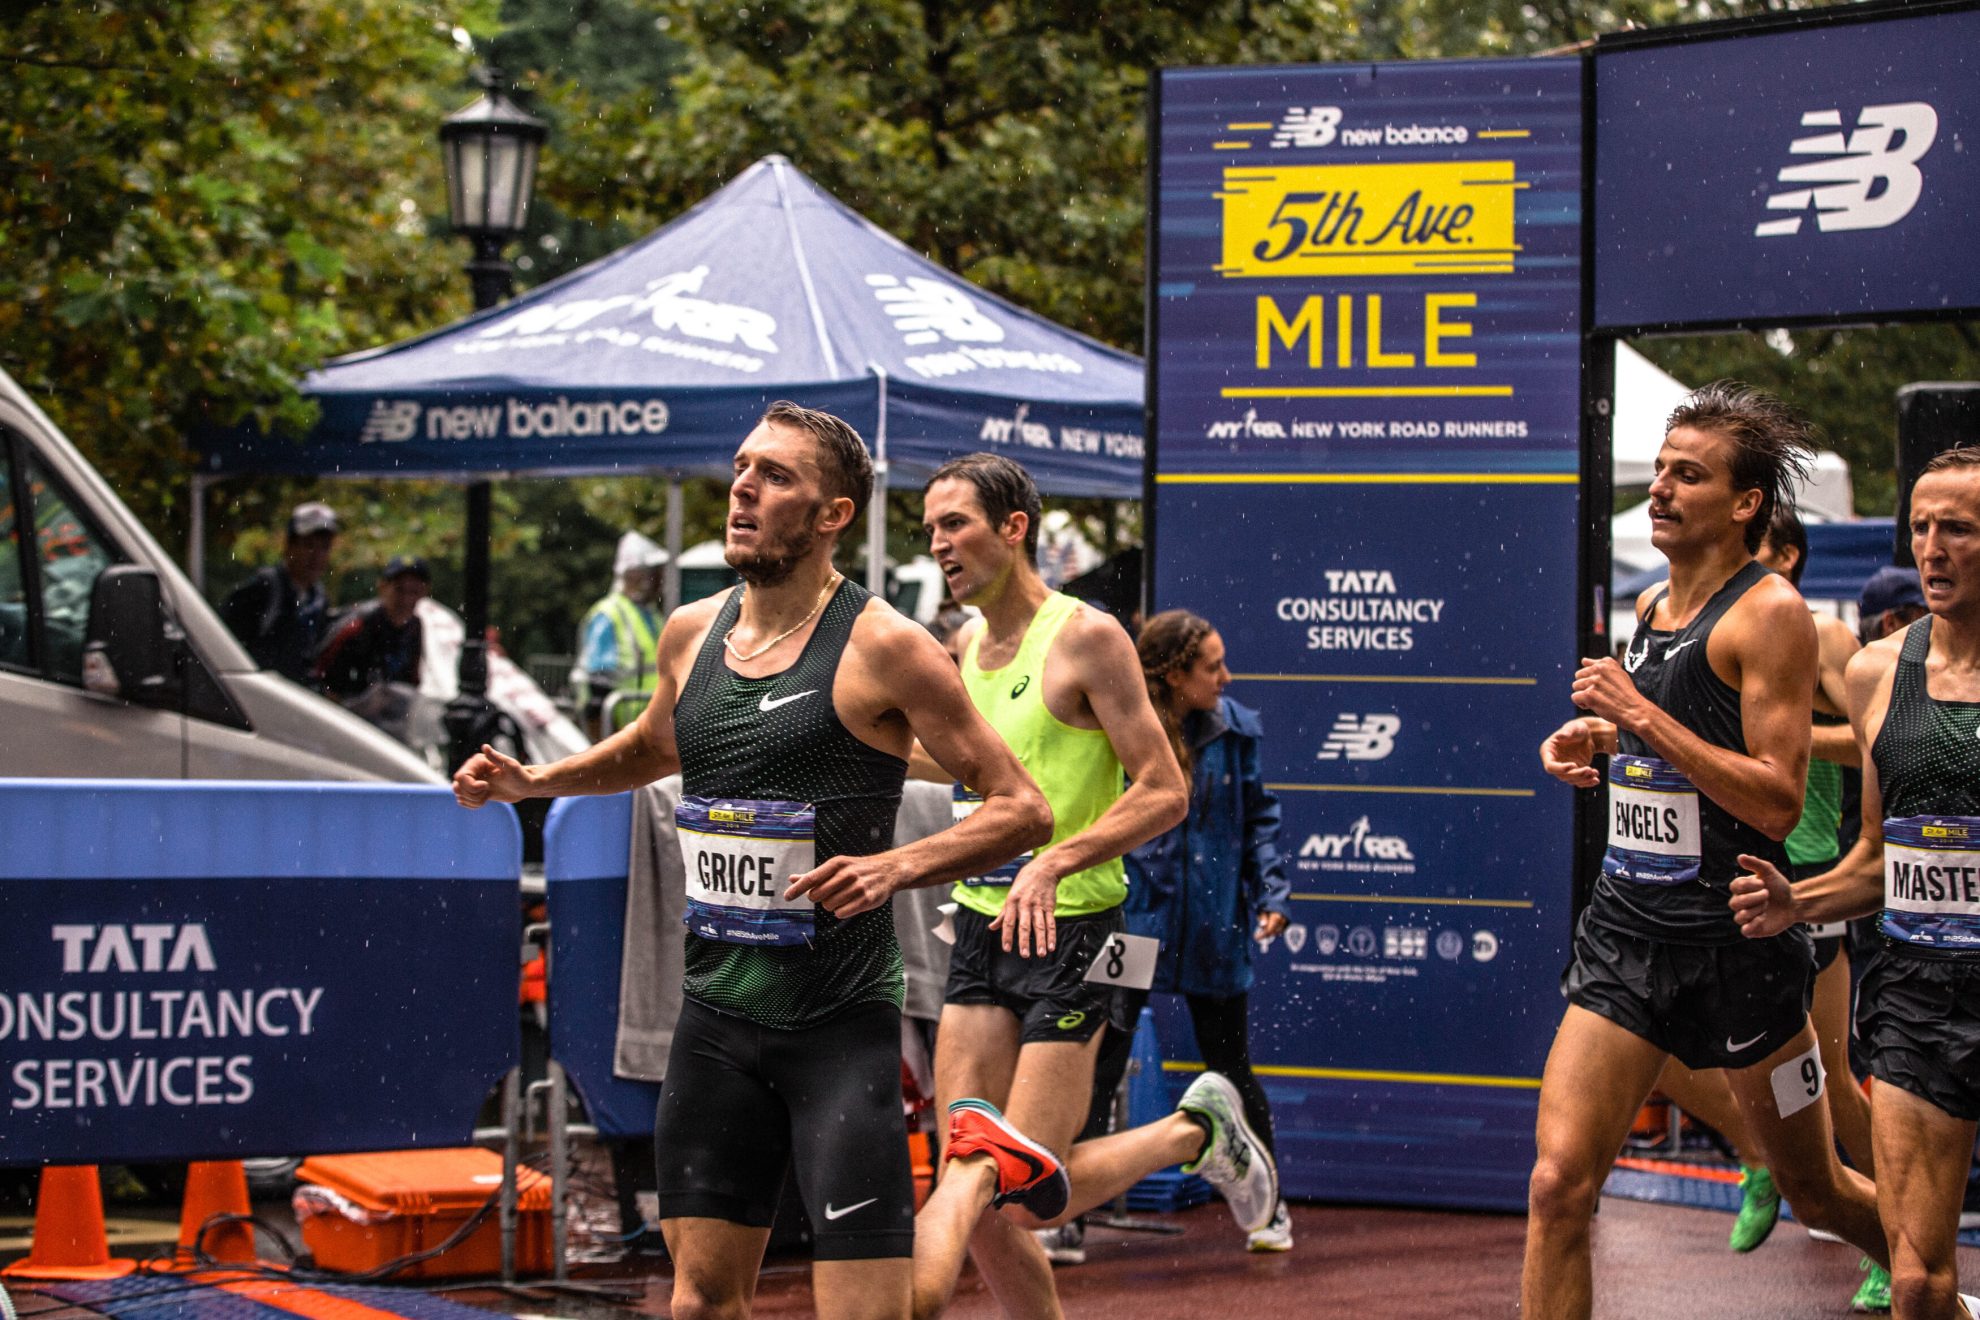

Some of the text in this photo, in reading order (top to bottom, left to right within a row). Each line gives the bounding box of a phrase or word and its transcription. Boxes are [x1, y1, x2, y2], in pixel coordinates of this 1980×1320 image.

[1341, 128, 1383, 146] new
[1385, 123, 1469, 145] balance
[1253, 189, 1474, 262] 5th Ave.
[1256, 293, 1477, 369] MILE
[427, 405, 500, 440] new
[507, 397, 670, 438] balance
[1291, 421, 1334, 438] NEW
[1337, 421, 1386, 438] YORK
[1389, 421, 1441, 438] ROAD
[1444, 421, 1529, 438] RUNNERS
[1060, 427, 1100, 453] NEW
[1325, 570, 1397, 593] TATA
[1276, 597, 1445, 622] CONSULTANCY
[1307, 626, 1414, 650] SERVICES
[1615, 800, 1679, 844] ENGELS
[698, 850, 775, 897] GRICE
[1893, 861, 1980, 902] MASTE
[52, 924, 217, 973] TATA
[1106, 939, 1126, 979] 8
[12, 1055, 254, 1109] SERVICES
[1800, 1057, 1818, 1097] 9
